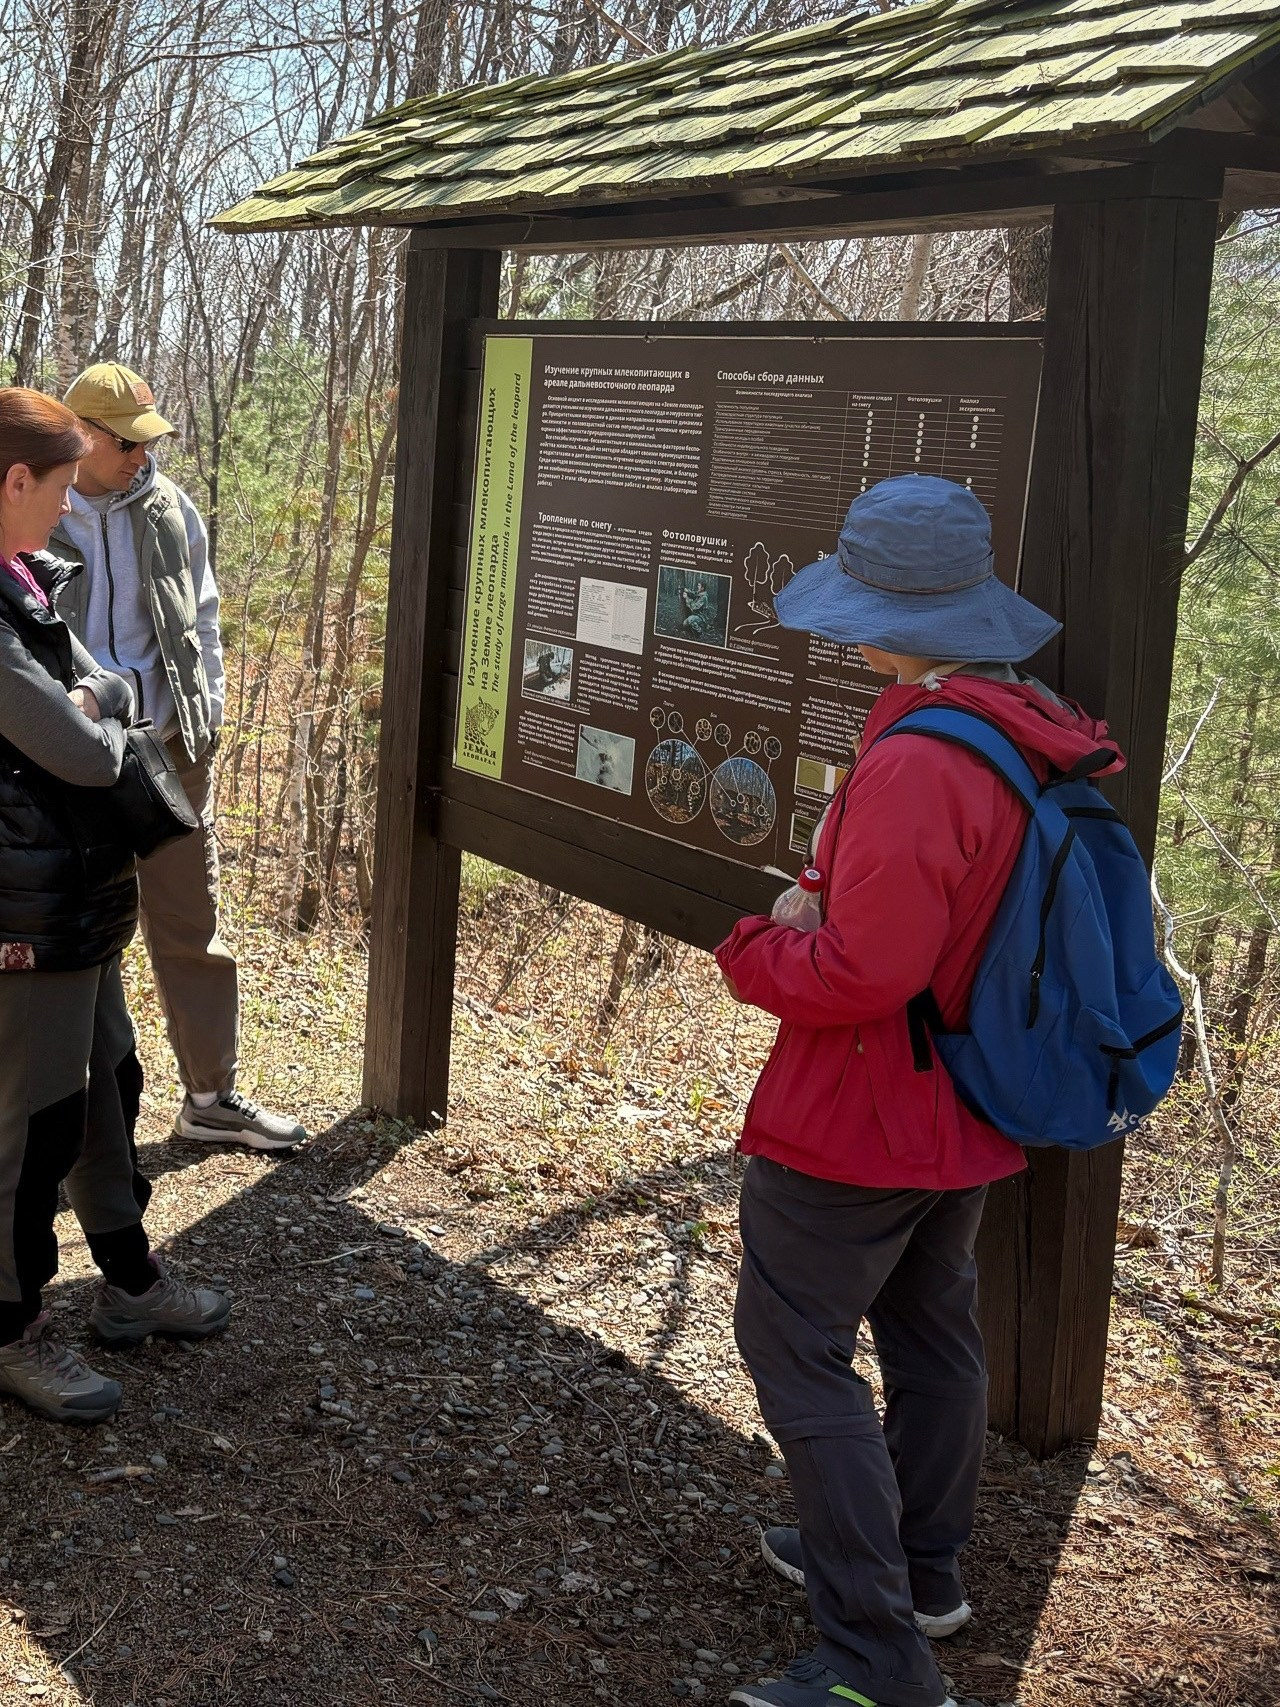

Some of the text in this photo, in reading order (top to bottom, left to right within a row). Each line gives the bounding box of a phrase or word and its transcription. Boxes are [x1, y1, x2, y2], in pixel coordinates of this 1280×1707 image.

[544, 365, 690, 379] Изучение крупных млекопитающих в
[716, 370, 824, 384] Способы сбора данных
[543, 379, 675, 393] ареале дальневосточного леопарда
[537, 511, 612, 532] Тропление по снегу
[467, 387, 497, 686] Изучение крупных млекопитающих
[491, 372, 522, 693] The study of large mammals in the Land of the leopard
[661, 529, 727, 546] Фотоловушки
[480, 534, 499, 690] на Земле леопарда
[462, 750, 496, 766] ЛЕОПАРДА
[463, 741, 497, 759] ЗЕМЛЯ
